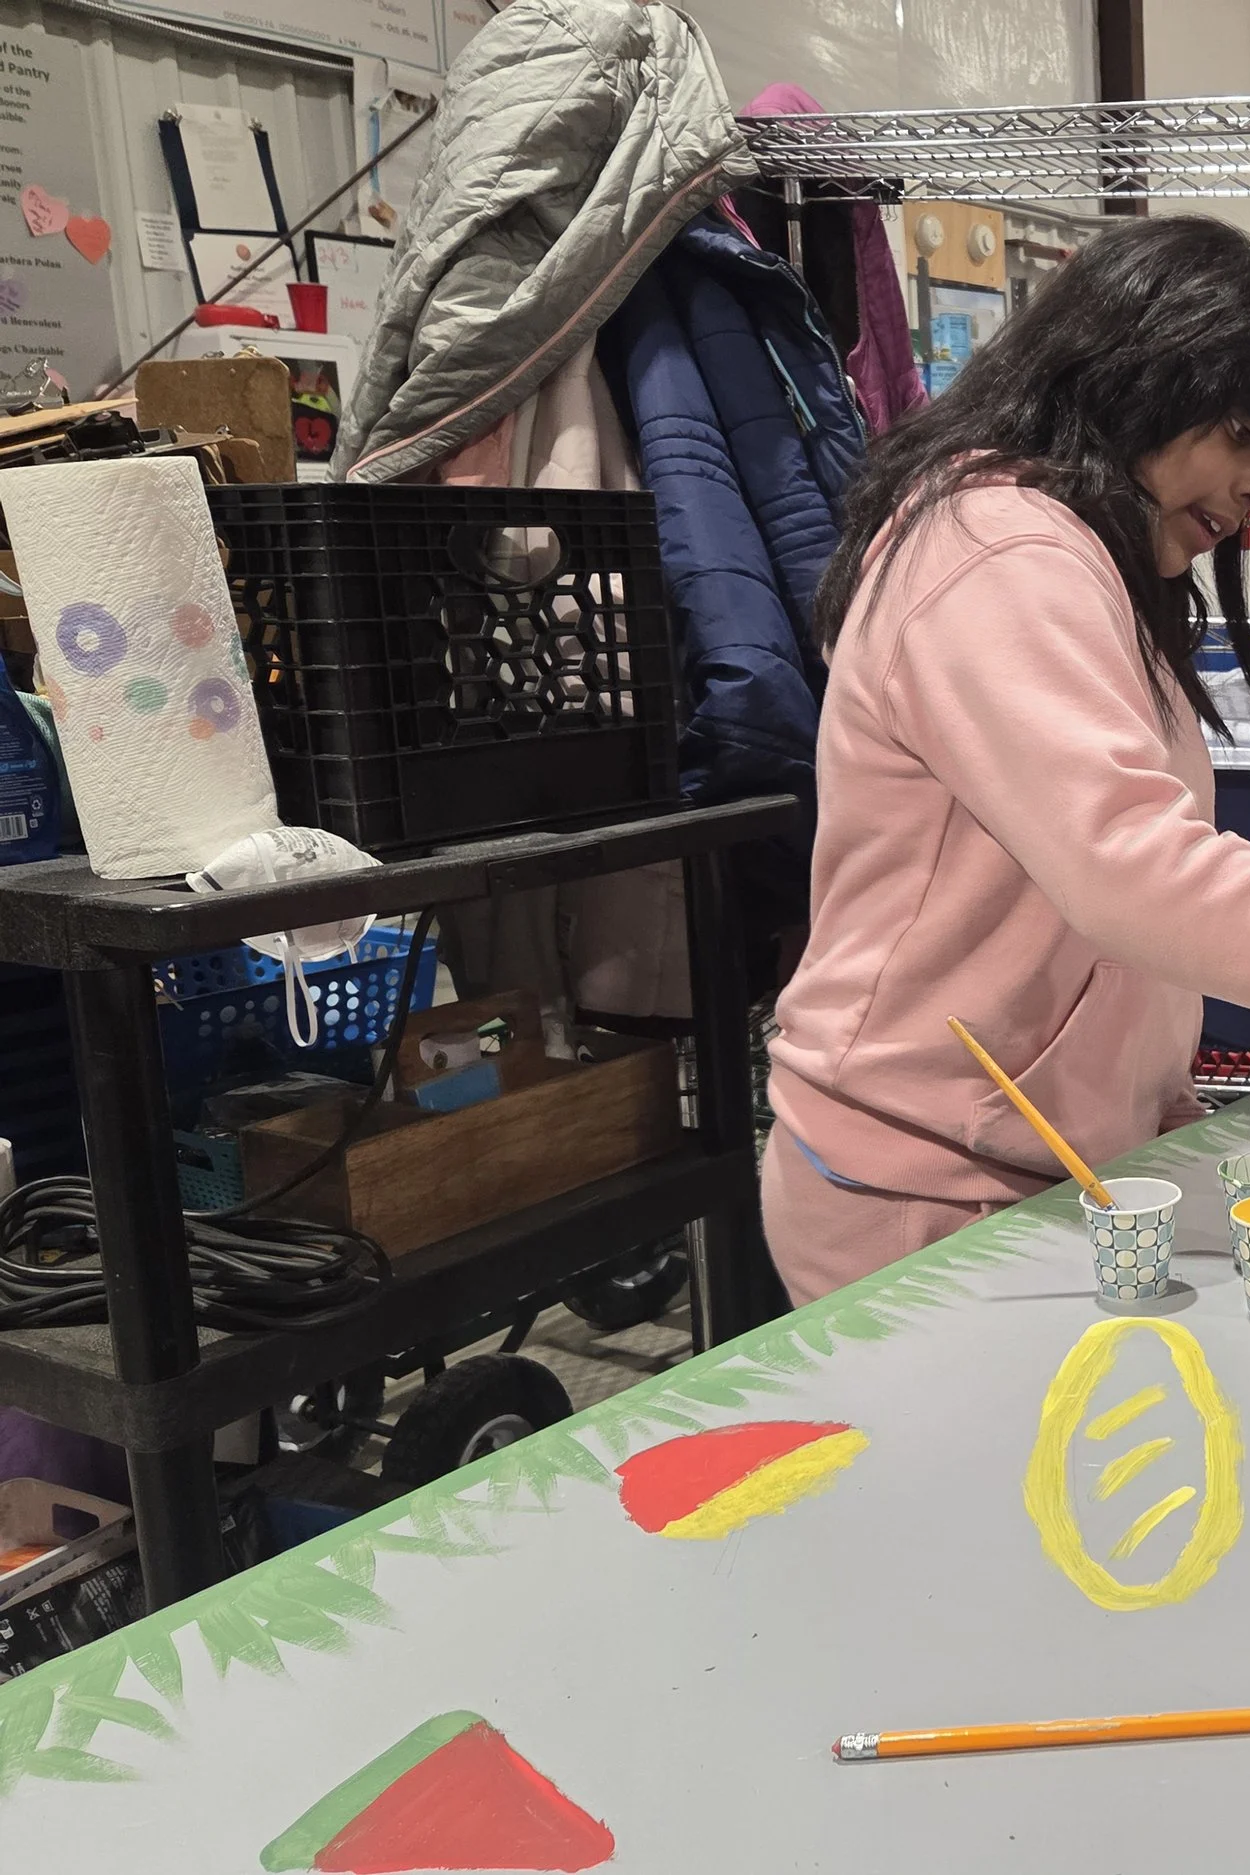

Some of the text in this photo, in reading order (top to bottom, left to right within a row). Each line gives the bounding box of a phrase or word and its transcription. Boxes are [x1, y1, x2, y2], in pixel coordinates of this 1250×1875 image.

[11, 44, 33, 58] the
[8, 61, 50, 83] Pantry
[11, 316, 62, 328] Benevolent
[14, 344, 64, 356] Charitable
